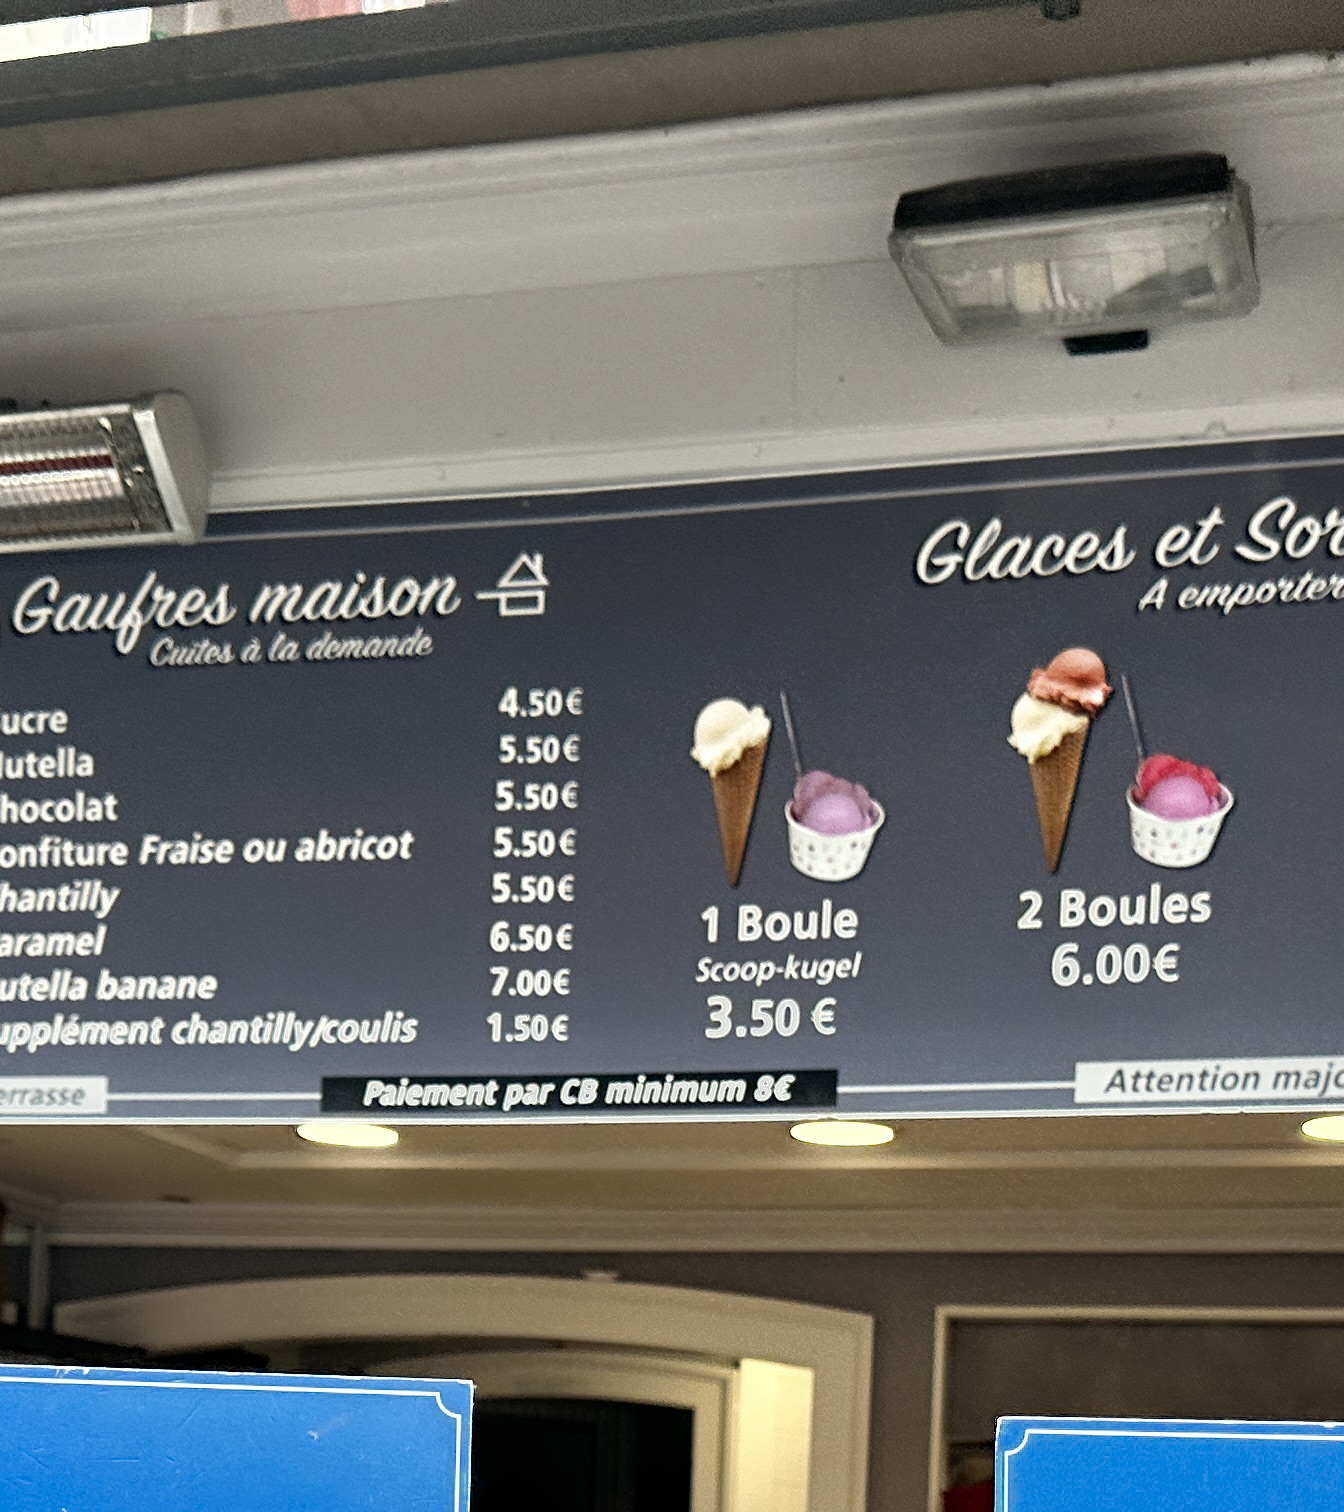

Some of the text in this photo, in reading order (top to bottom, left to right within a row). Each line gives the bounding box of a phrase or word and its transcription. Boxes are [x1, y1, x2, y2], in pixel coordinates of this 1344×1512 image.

[917, 518, 1136, 583] Glaces
[1156, 507, 1224, 567] et
[1139, 578, 1168, 610] A
[14, 572, 461, 653] Gaufres maison
[151, 628, 432, 665] Cuites à la demande
[499, 688, 582, 717] 4.50€
[500, 735, 579, 763] 5.50€
[496, 780, 577, 811] 5.50€
[140, 833, 234, 864] Fraise
[243, 840, 286, 863] ou
[295, 829, 414, 861] abricot
[494, 827, 575, 857] 5.50€
[492, 873, 574, 903] 5.50€
[702, 899, 858, 942] 1 Boule
[1018, 883, 1211, 929] 2 Boules
[490, 921, 572, 952] 6.50€
[696, 952, 862, 986] Scoop-kugel
[1052, 943, 1179, 986] 6.00€
[96, 969, 217, 1000] banane
[490, 967, 569, 996] 7.00€
[171, 1011, 418, 1051] chantilly/coulis
[487, 1012, 568, 1042] 1.50€
[363, 1074, 796, 1112] Paiement par CB minimum 8€
[1104, 1064, 1259, 1095] Attention
